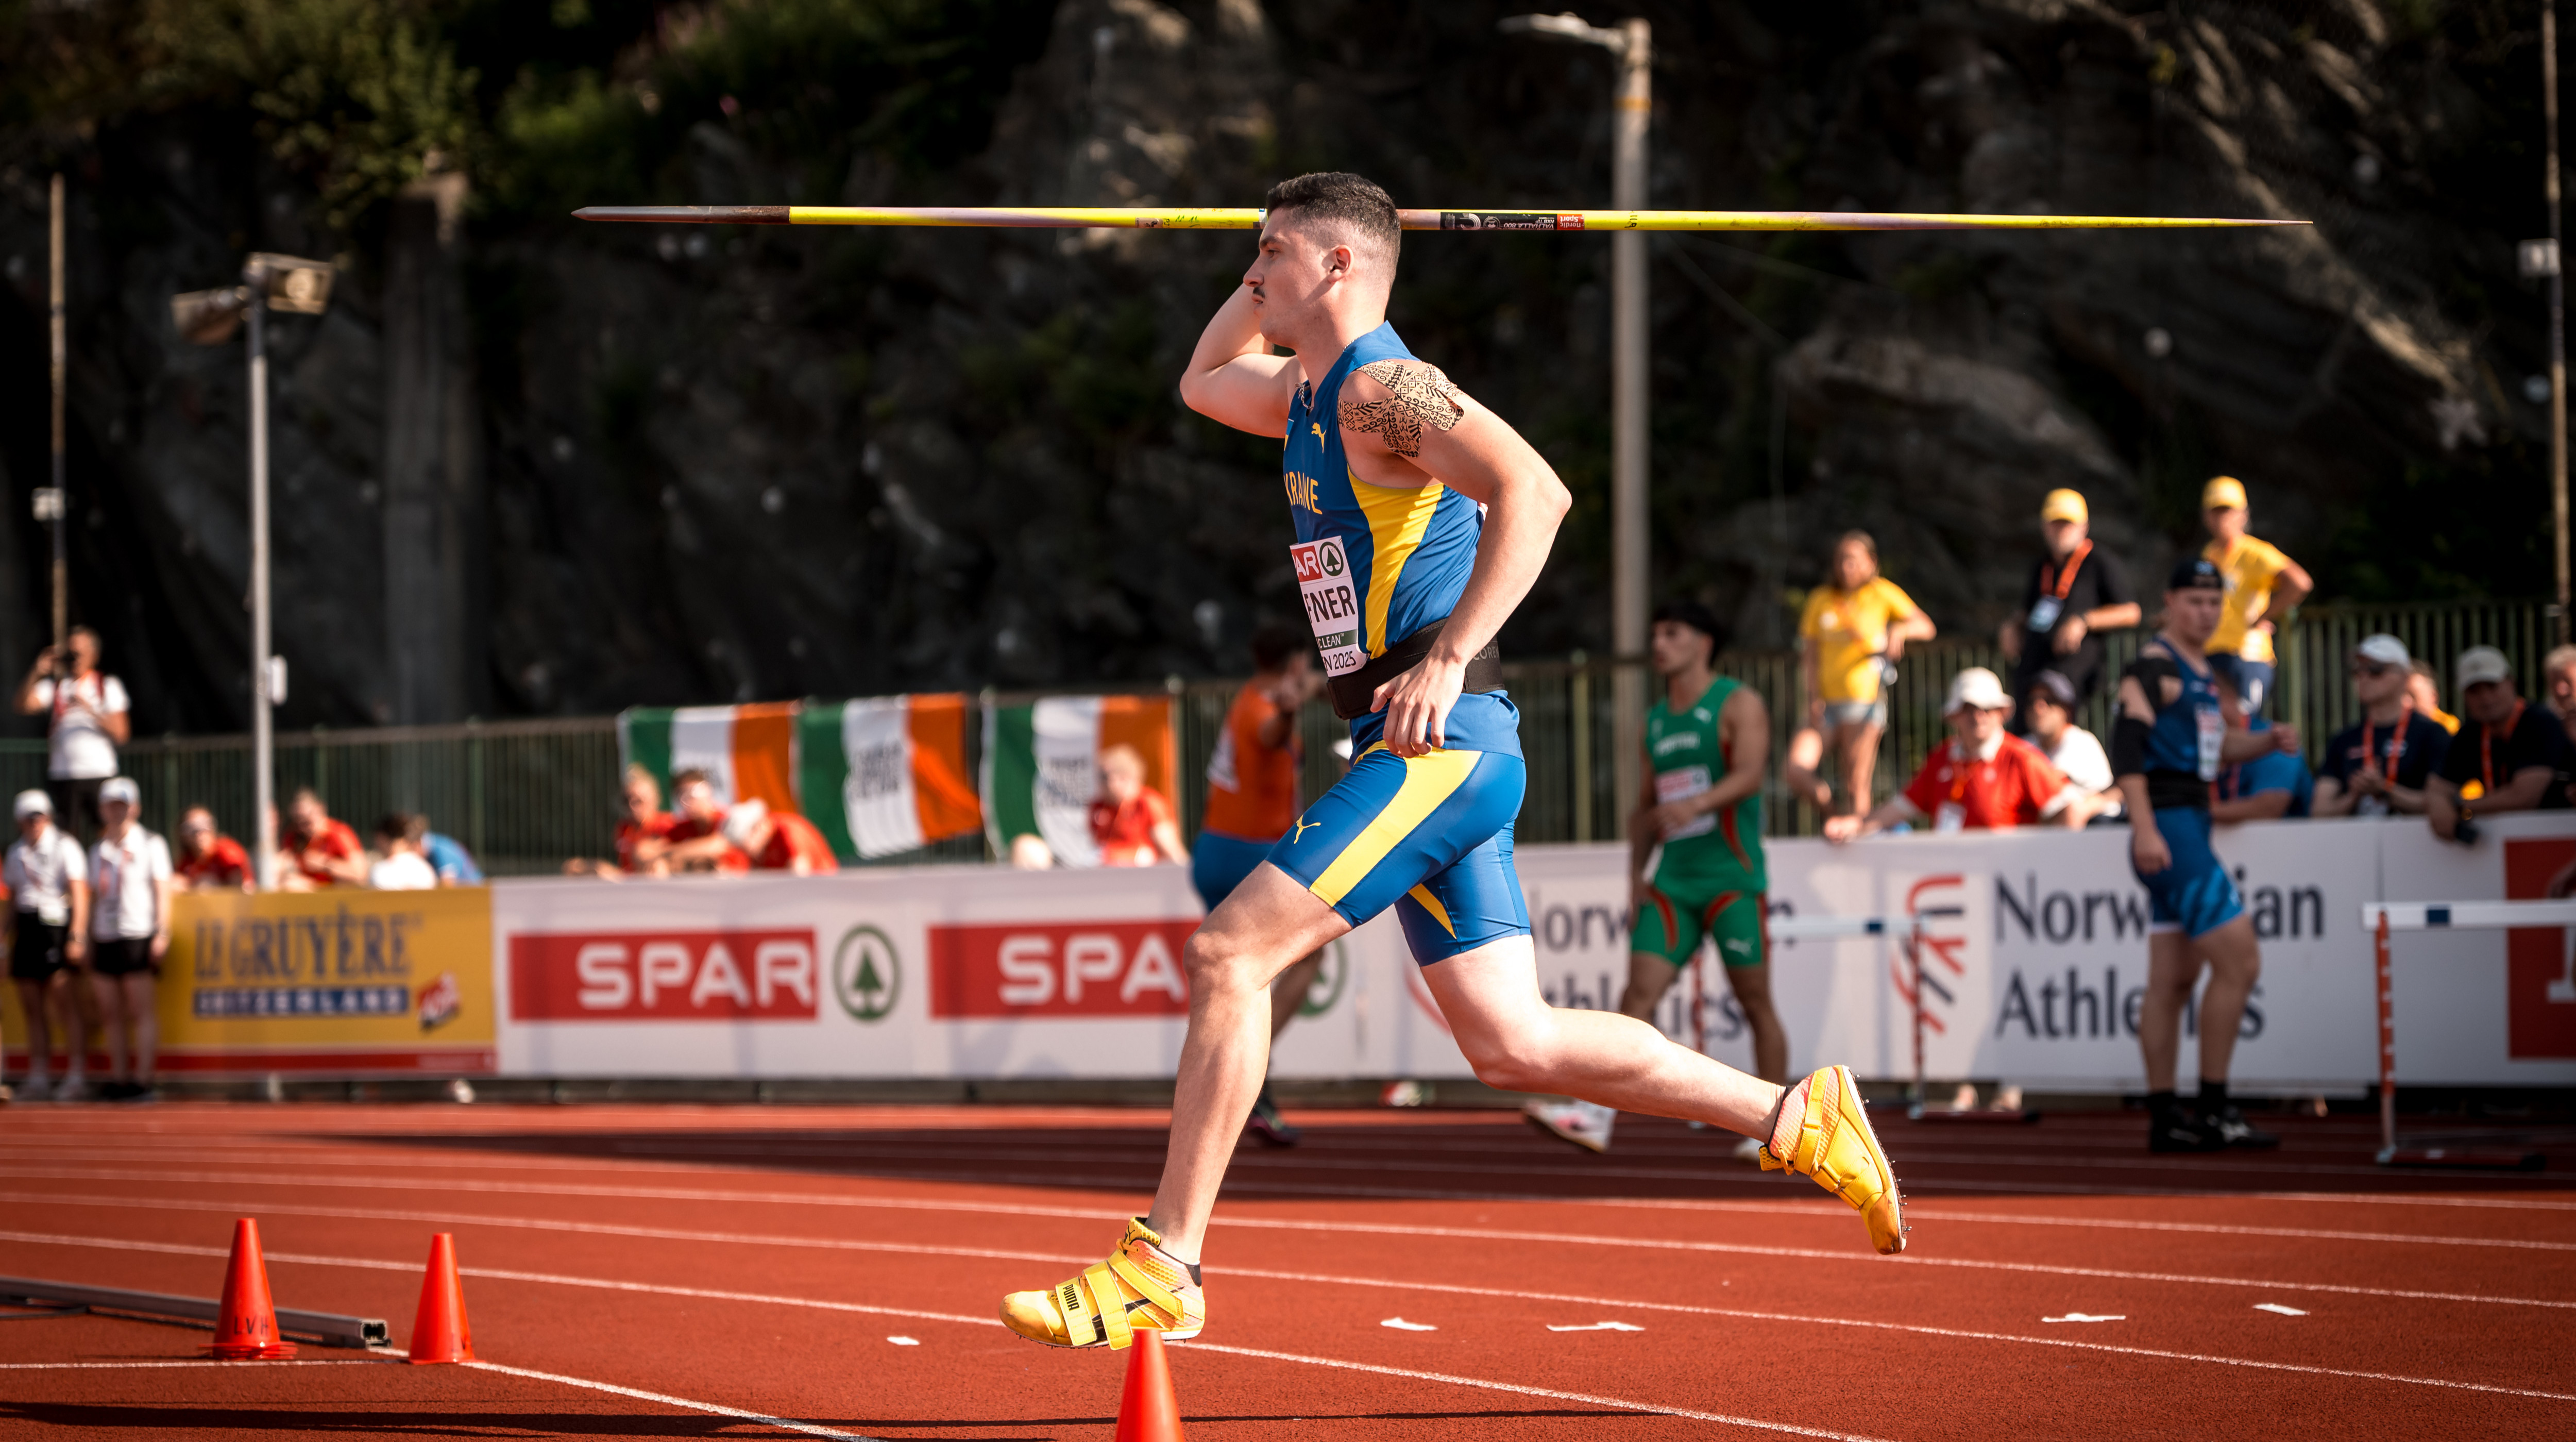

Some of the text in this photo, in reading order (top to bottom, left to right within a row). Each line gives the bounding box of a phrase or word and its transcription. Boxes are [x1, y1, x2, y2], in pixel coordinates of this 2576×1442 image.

[1292, 551, 1319, 577] AR
[1322, 650, 1357, 671] N 2025
[575, 941, 814, 1010] SPAR
[1063, 1283, 1080, 1311] PUMA
